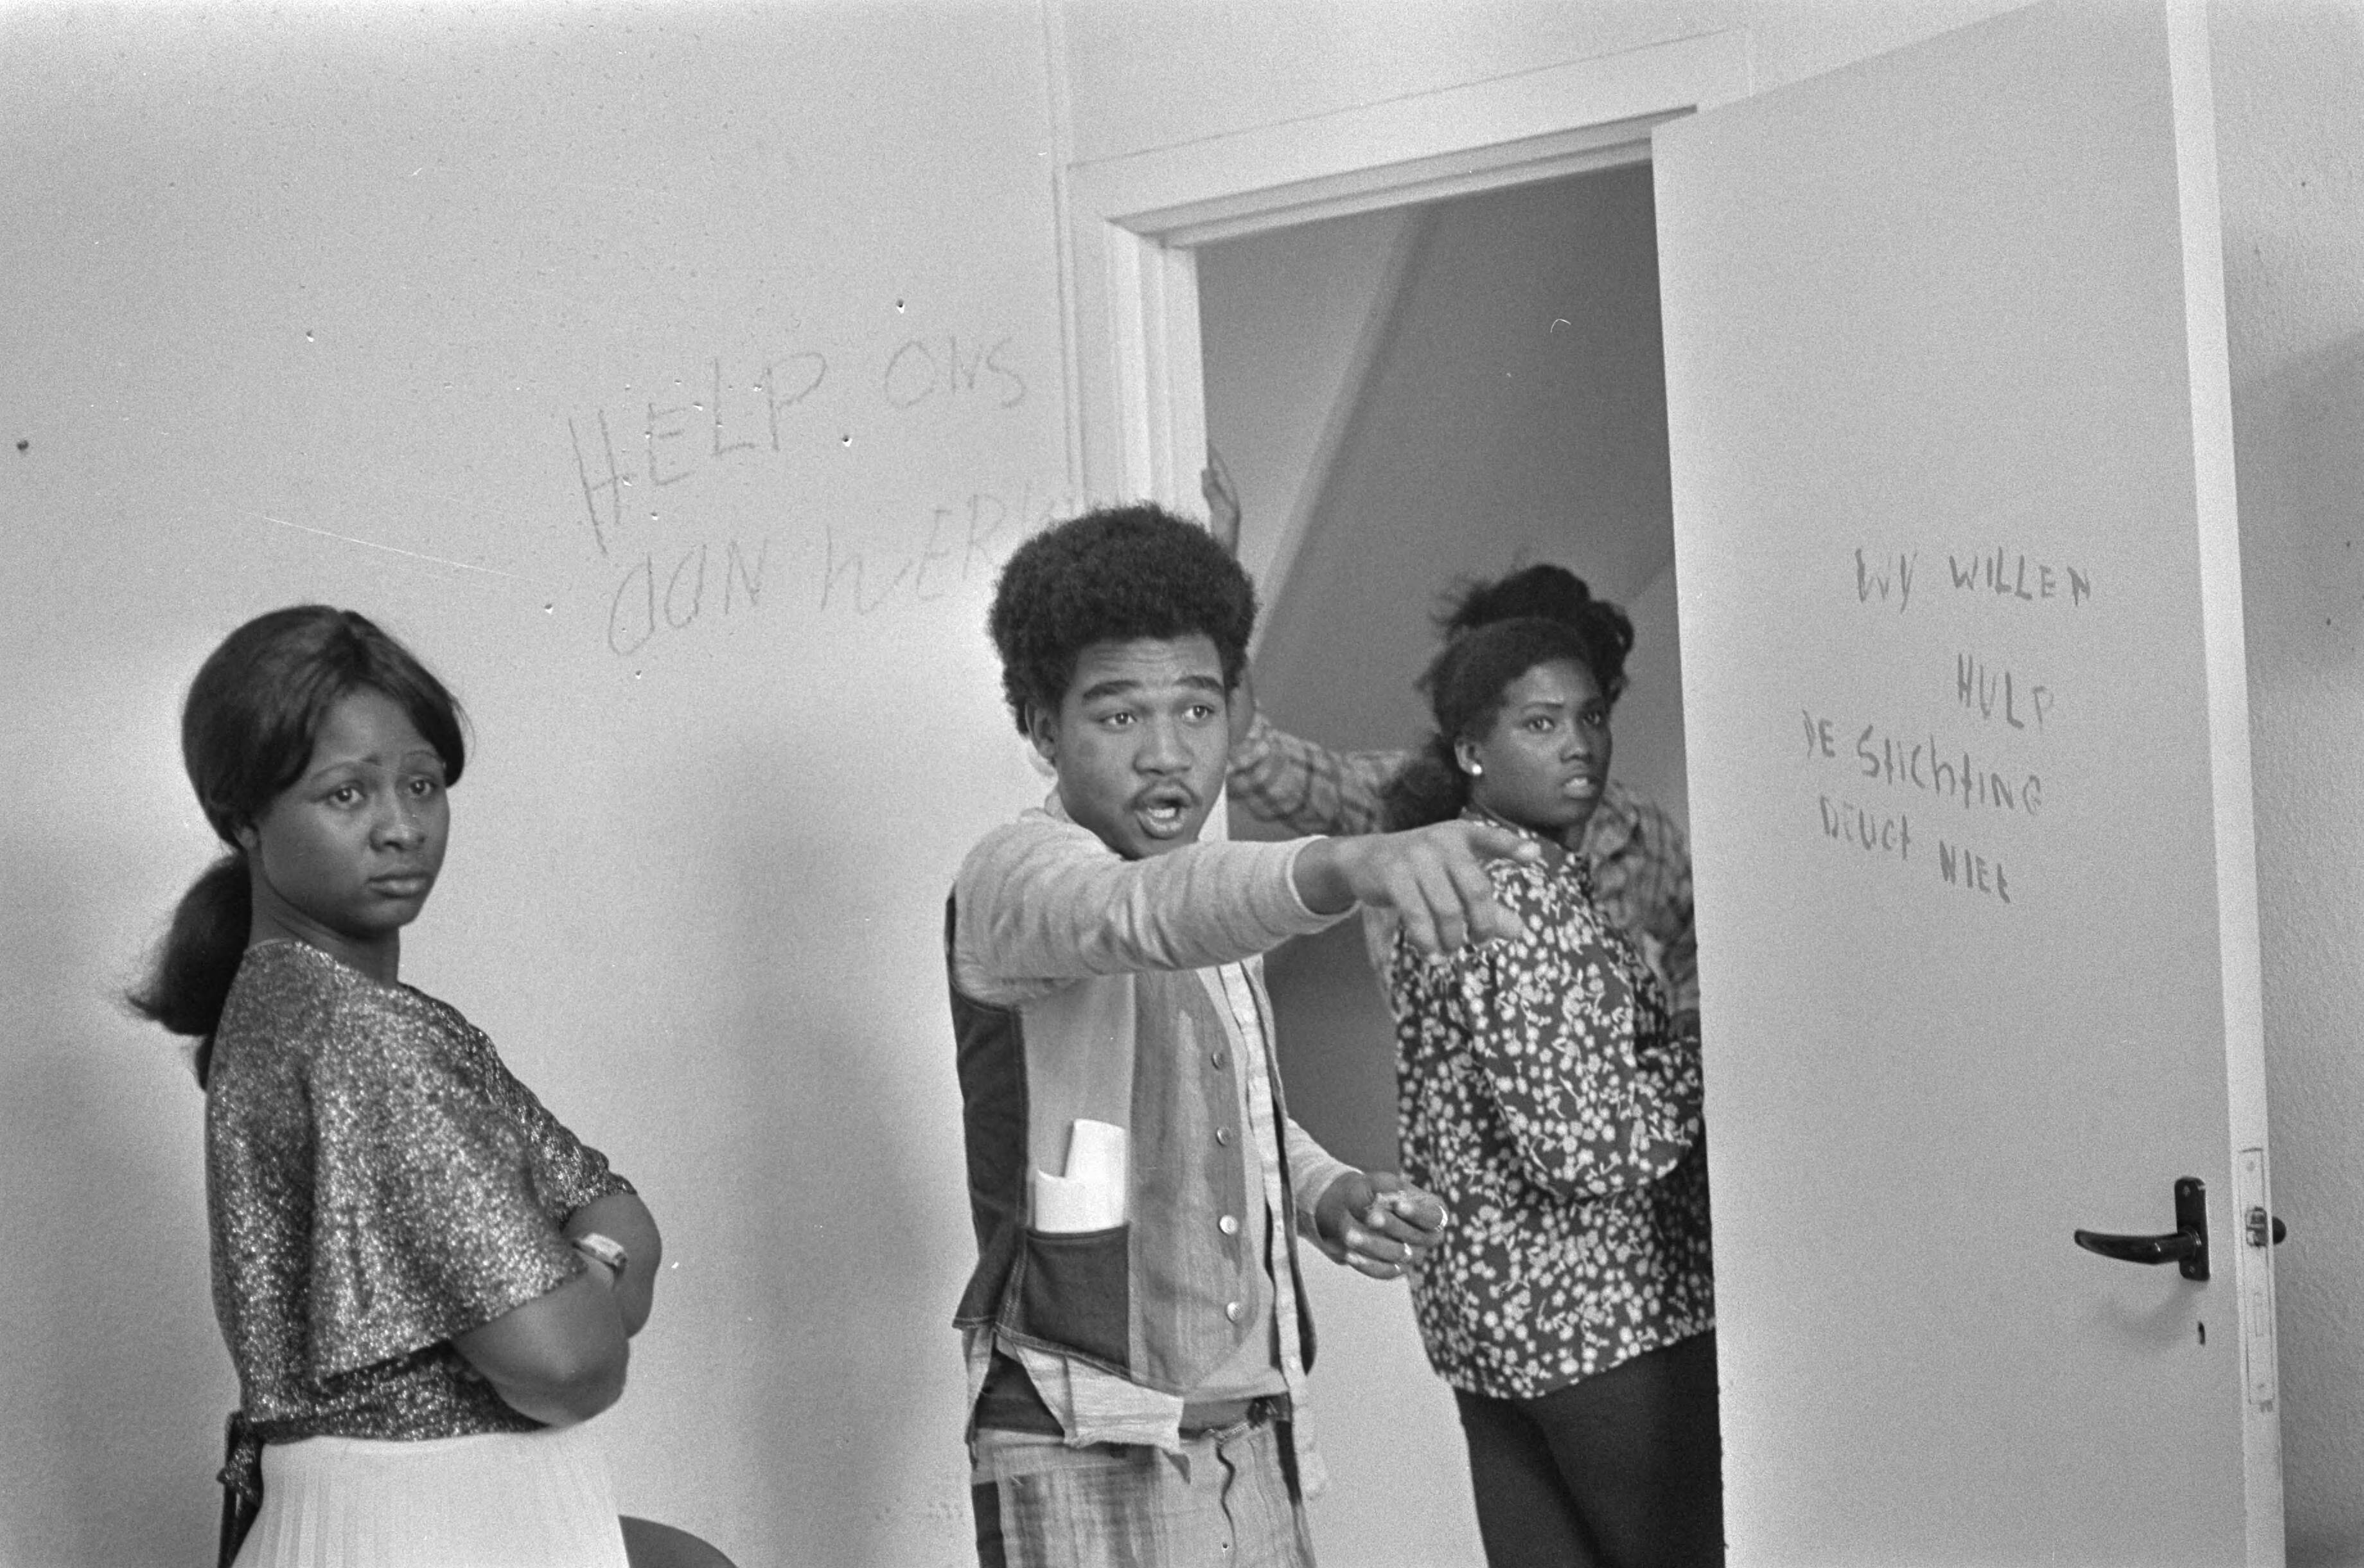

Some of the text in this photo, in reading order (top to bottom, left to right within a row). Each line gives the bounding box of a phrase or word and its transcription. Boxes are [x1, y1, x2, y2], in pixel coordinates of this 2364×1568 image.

[569, 336, 1027, 556] HELP ONS
[1948, 546, 2091, 607] WILLEN
[1957, 653, 2054, 734] HULP
